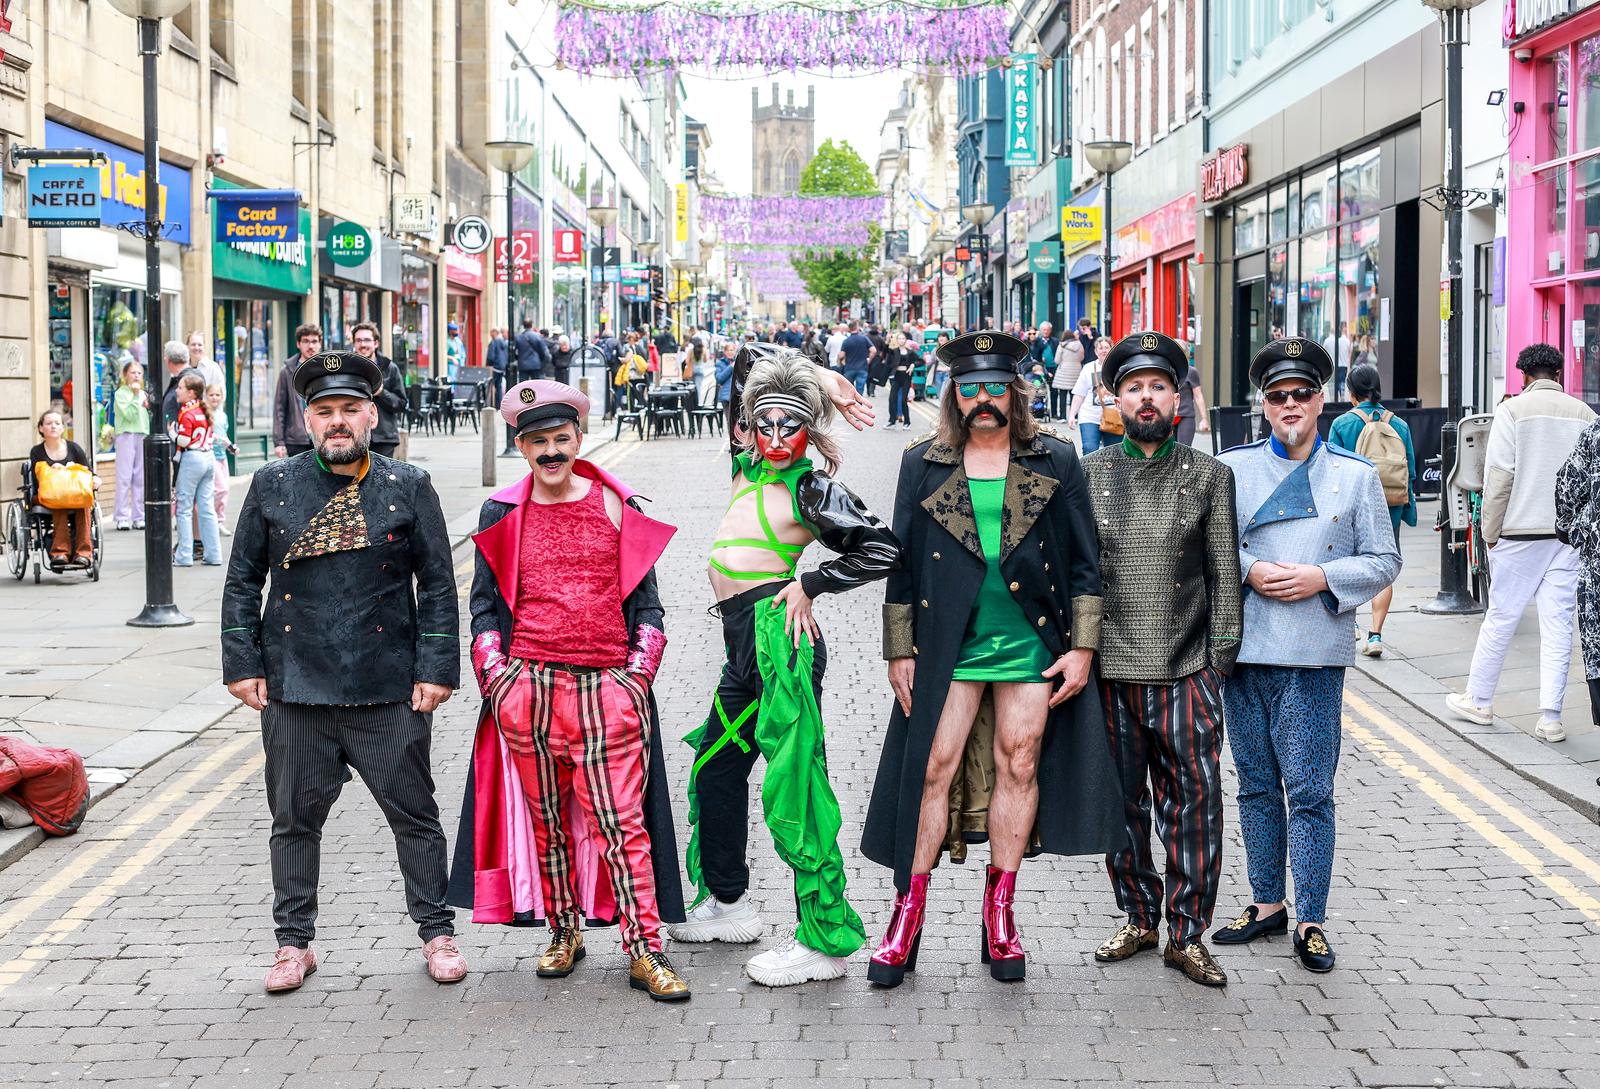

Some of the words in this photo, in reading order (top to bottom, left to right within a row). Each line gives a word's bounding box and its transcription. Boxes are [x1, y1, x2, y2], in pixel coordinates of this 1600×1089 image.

[1014, 58, 1029, 150] AKASYA
[32, 193, 96, 206] NERO
[238, 207, 277, 221] Card
[1071, 210, 1088, 219] The
[226, 222, 288, 239] Factory
[1065, 219, 1094, 228] Works
[1422, 467, 1442, 482] Coca
